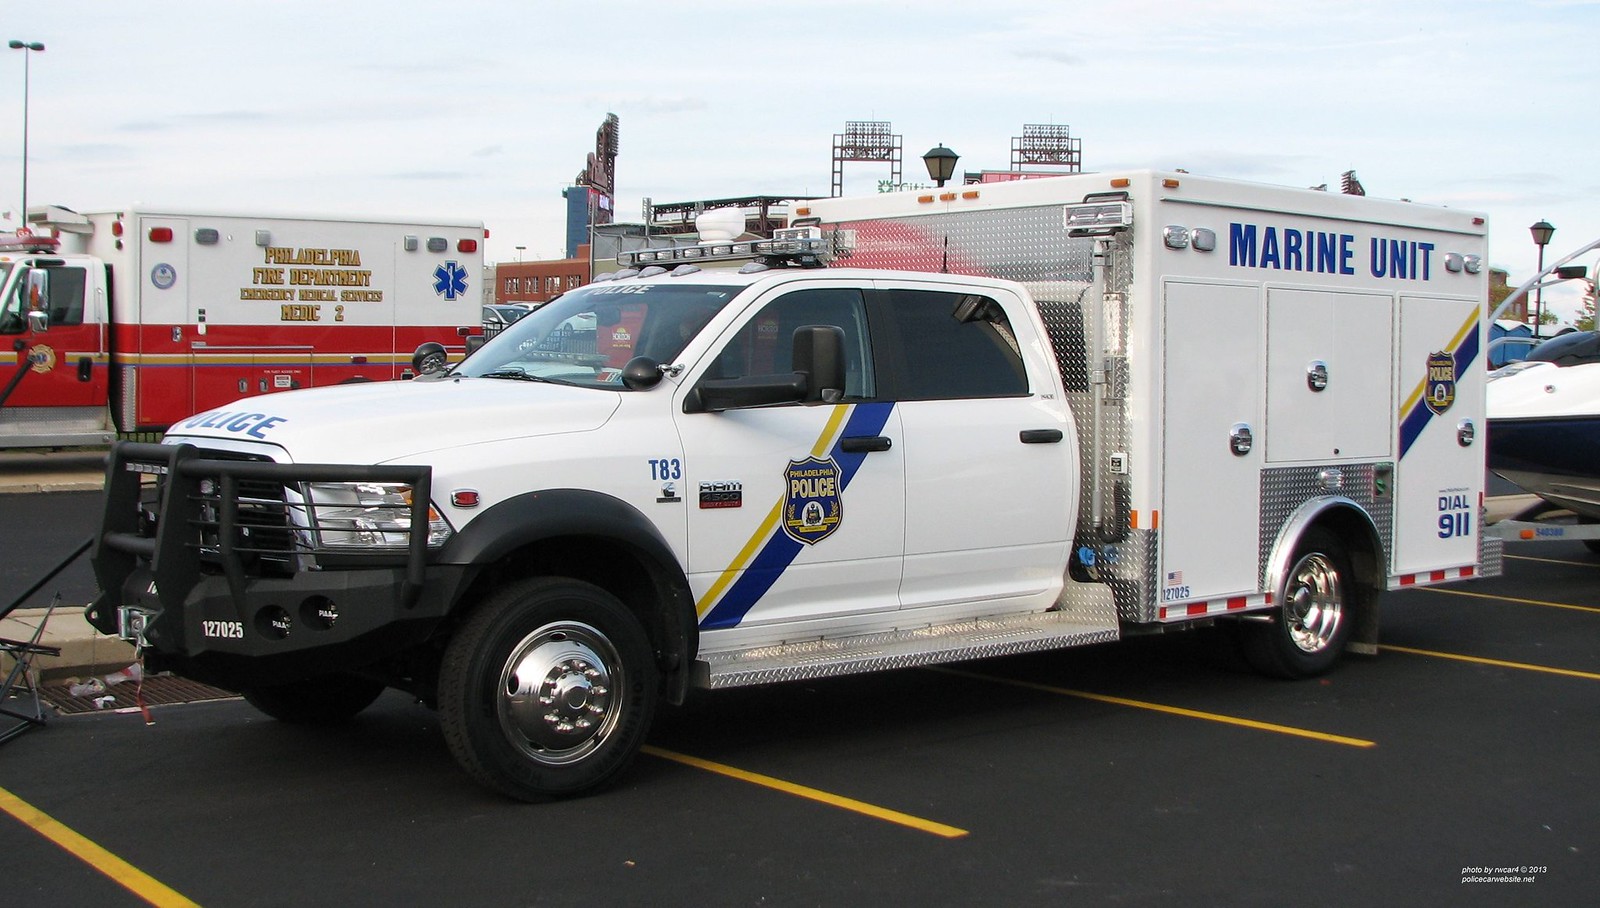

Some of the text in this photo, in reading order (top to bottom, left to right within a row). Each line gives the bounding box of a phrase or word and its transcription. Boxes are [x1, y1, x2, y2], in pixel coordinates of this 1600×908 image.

[264, 246, 361, 266] PHILADELPHIA
[1229, 222, 1435, 281] MARINE UNIT
[252, 267, 372, 287] FIRE DEPARTMENT
[239, 288, 383, 302] EMERGENCY MEDICAL SERVICES
[280, 304, 345, 322] MEDIC 2
[1429, 366, 1453, 381] POLICE
[648, 458, 681, 480] T83
[789, 469, 835, 478] PHILADELPHIA
[699, 481, 743, 492] RAM
[791, 478, 835, 499] POLICE
[1438, 494, 1470, 511] DIAL
[1437, 512, 1470, 539] 911
[1162, 586, 1190, 600] 127025
[202, 620, 244, 639] 127025
